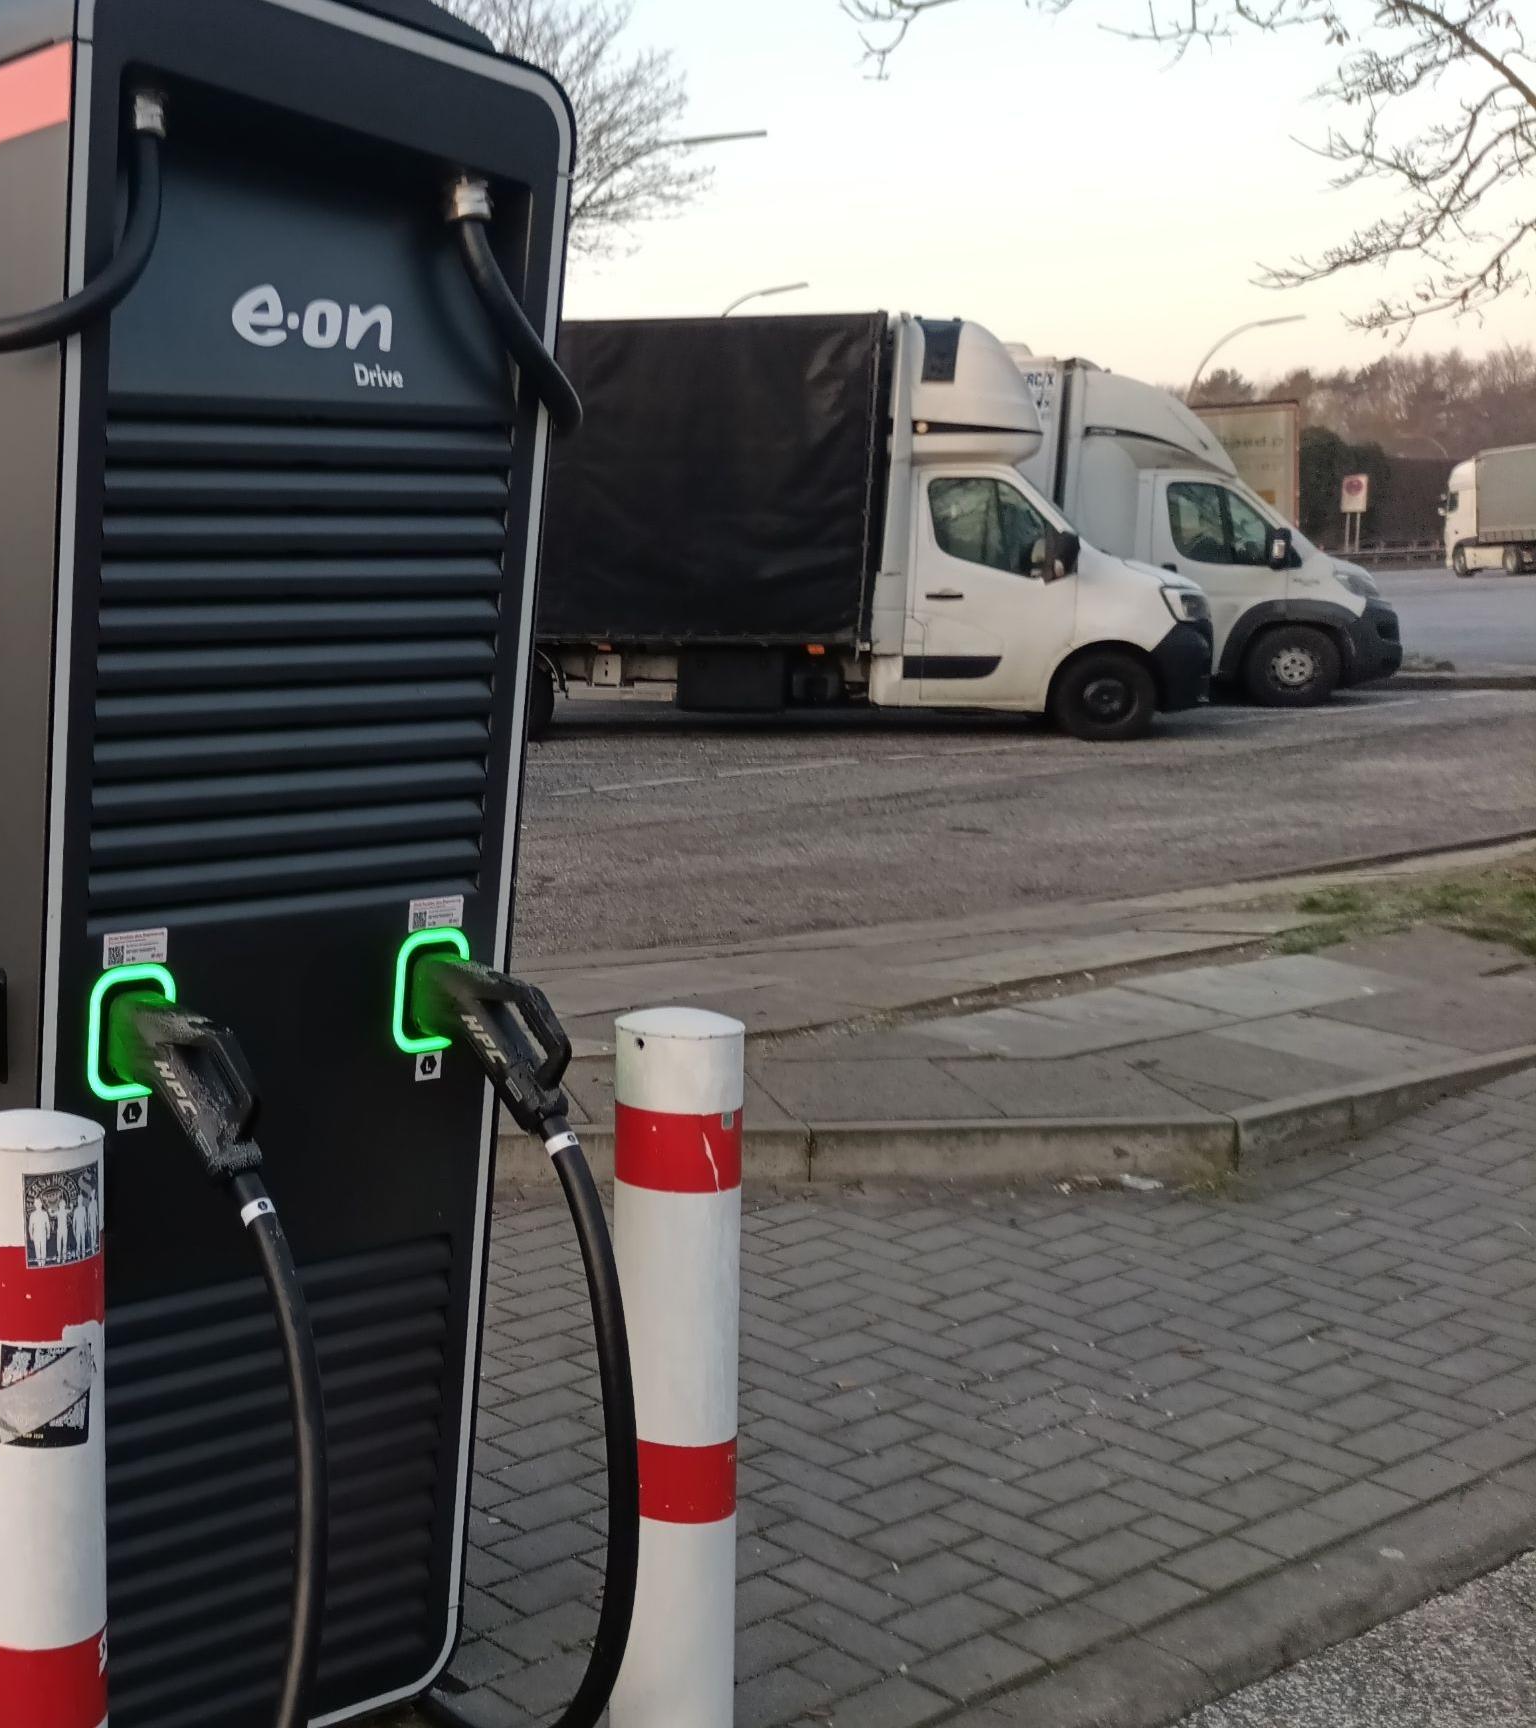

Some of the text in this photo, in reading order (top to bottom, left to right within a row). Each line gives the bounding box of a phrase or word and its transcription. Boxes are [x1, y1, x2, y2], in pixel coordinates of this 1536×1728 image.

[353, 362, 405, 389] Drive
[460, 1013, 508, 1065] HPC
[154, 1060, 199, 1116] HPC
